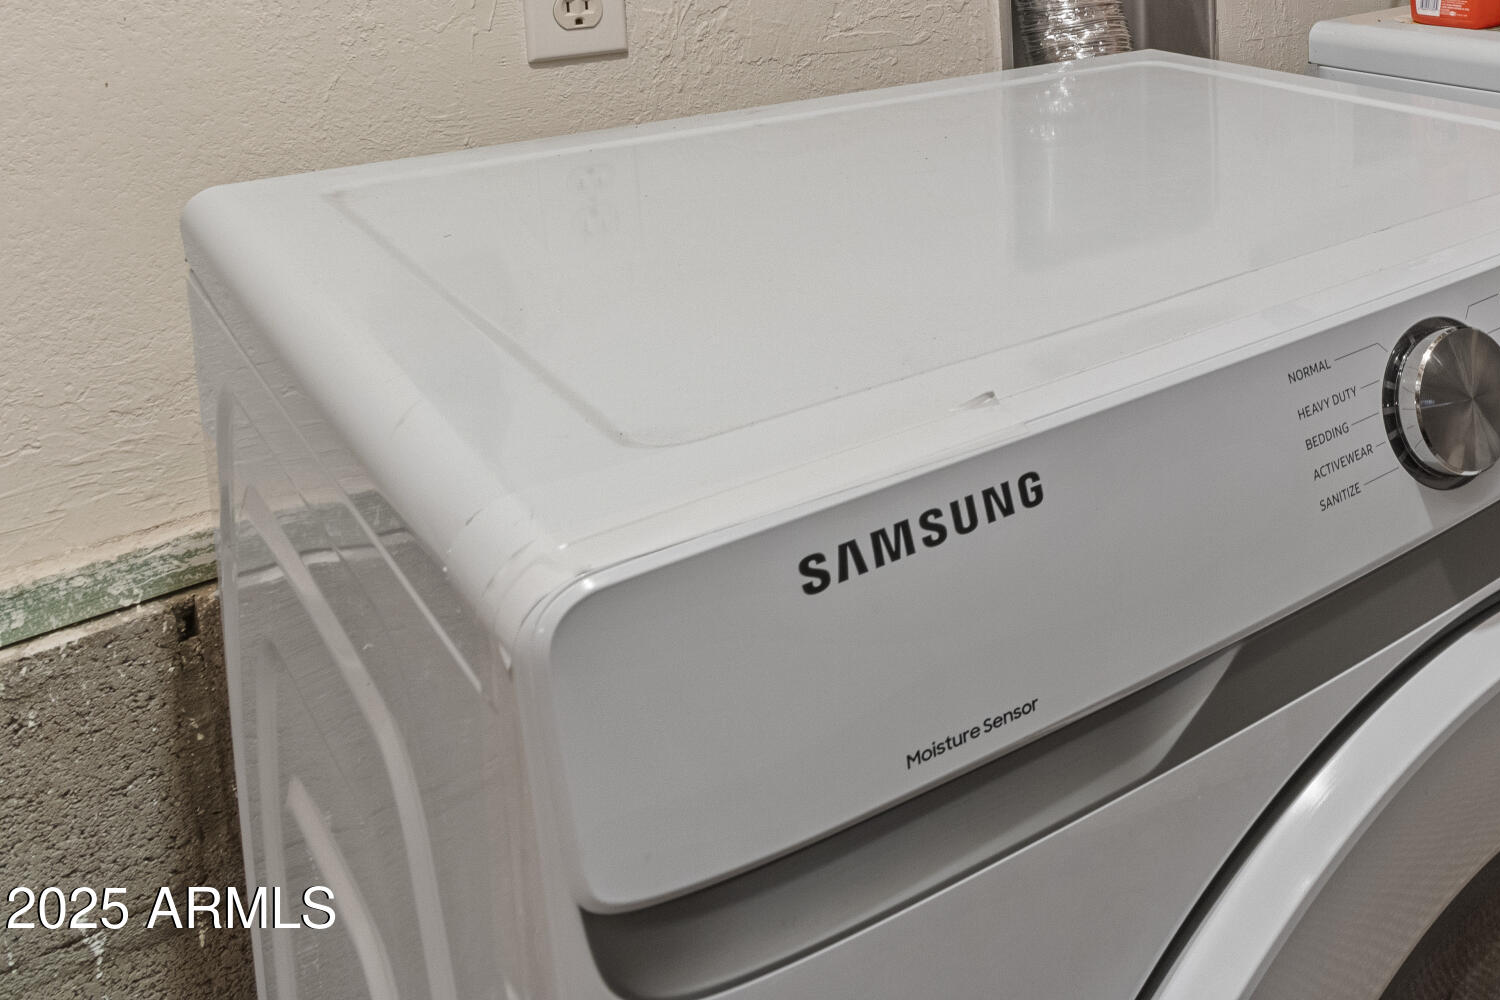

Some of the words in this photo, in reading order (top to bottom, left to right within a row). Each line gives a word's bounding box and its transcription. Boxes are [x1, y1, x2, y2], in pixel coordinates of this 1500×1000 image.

[1288, 359, 1331, 384] NORMAL
[1297, 398, 1330, 420] HEAVY
[1332, 386, 1357, 406] DUTY
[1305, 422, 1349, 450] BEDDING
[1314, 443, 1374, 481] ACTIVEWEAR
[1320, 482, 1361, 512] SANITIZE
[798, 471, 1044, 596] SAMSUNG
[906, 725, 981, 770] Moisture
[983, 697, 1039, 732] Sensor
